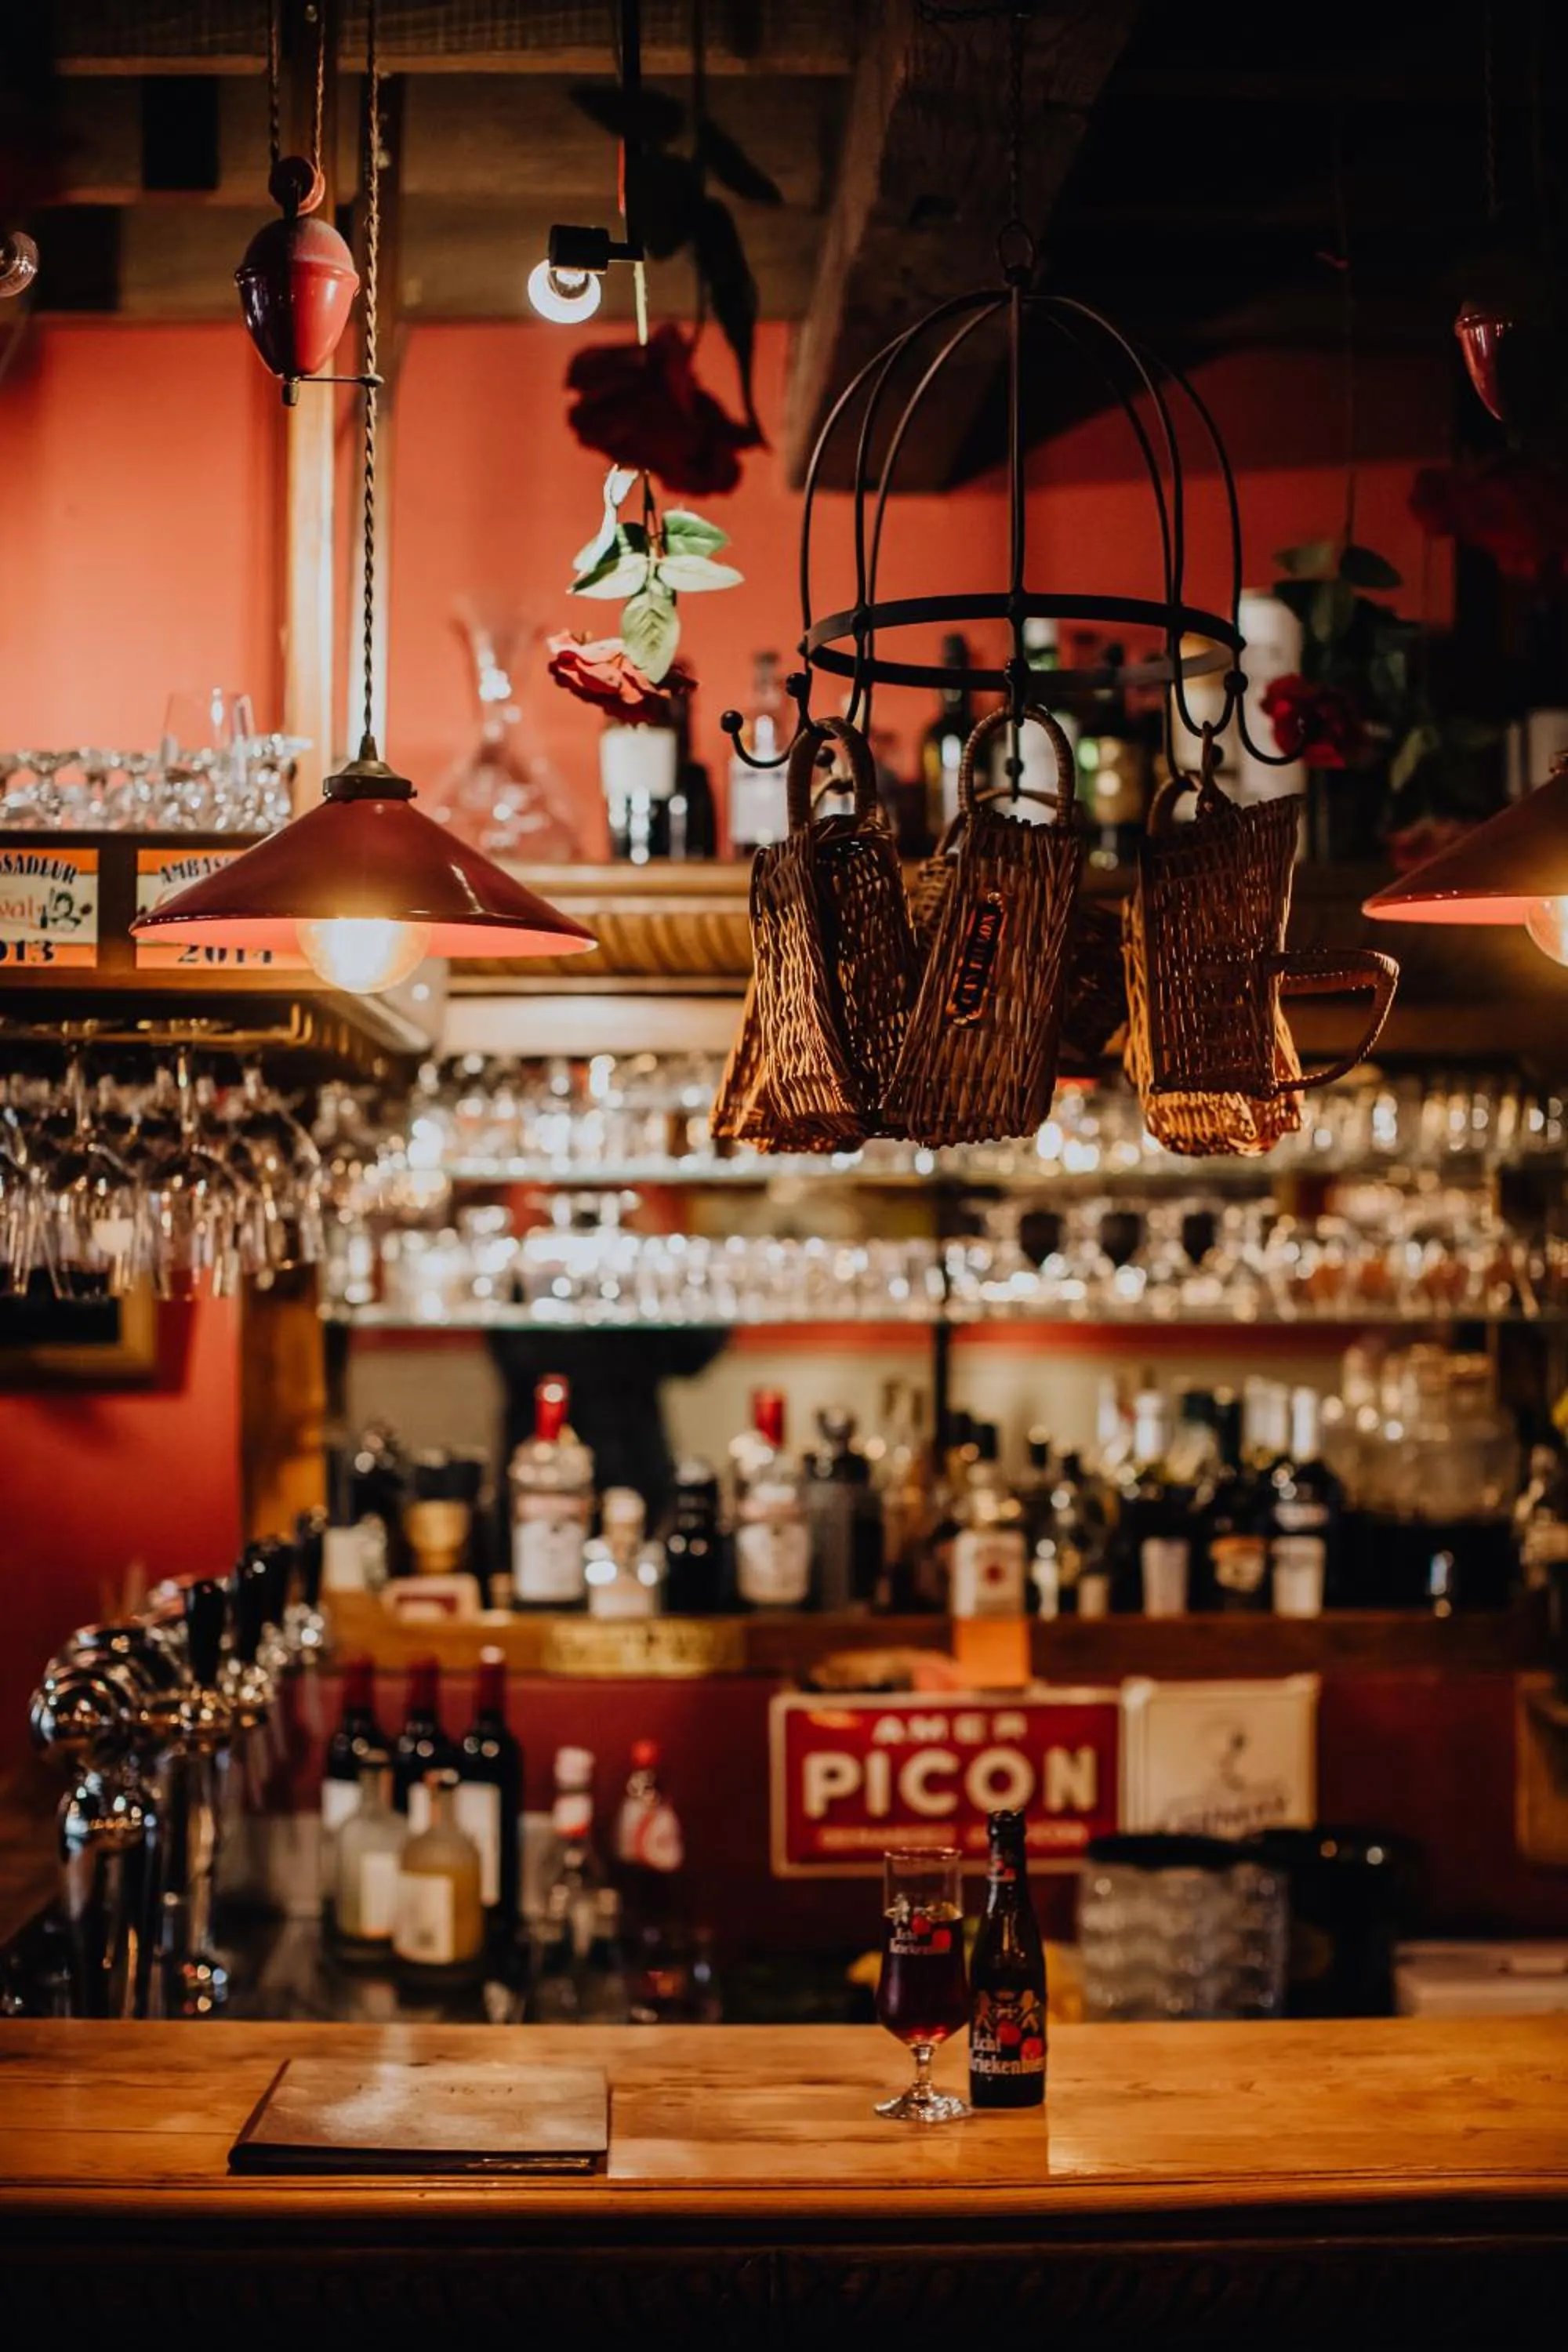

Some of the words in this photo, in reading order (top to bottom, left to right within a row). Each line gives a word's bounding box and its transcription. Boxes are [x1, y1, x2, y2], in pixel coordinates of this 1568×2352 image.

[0, 853, 77, 884] SADEUR
[871, 1711, 1028, 1745] AMER
[802, 1746, 1096, 1818] PICON
